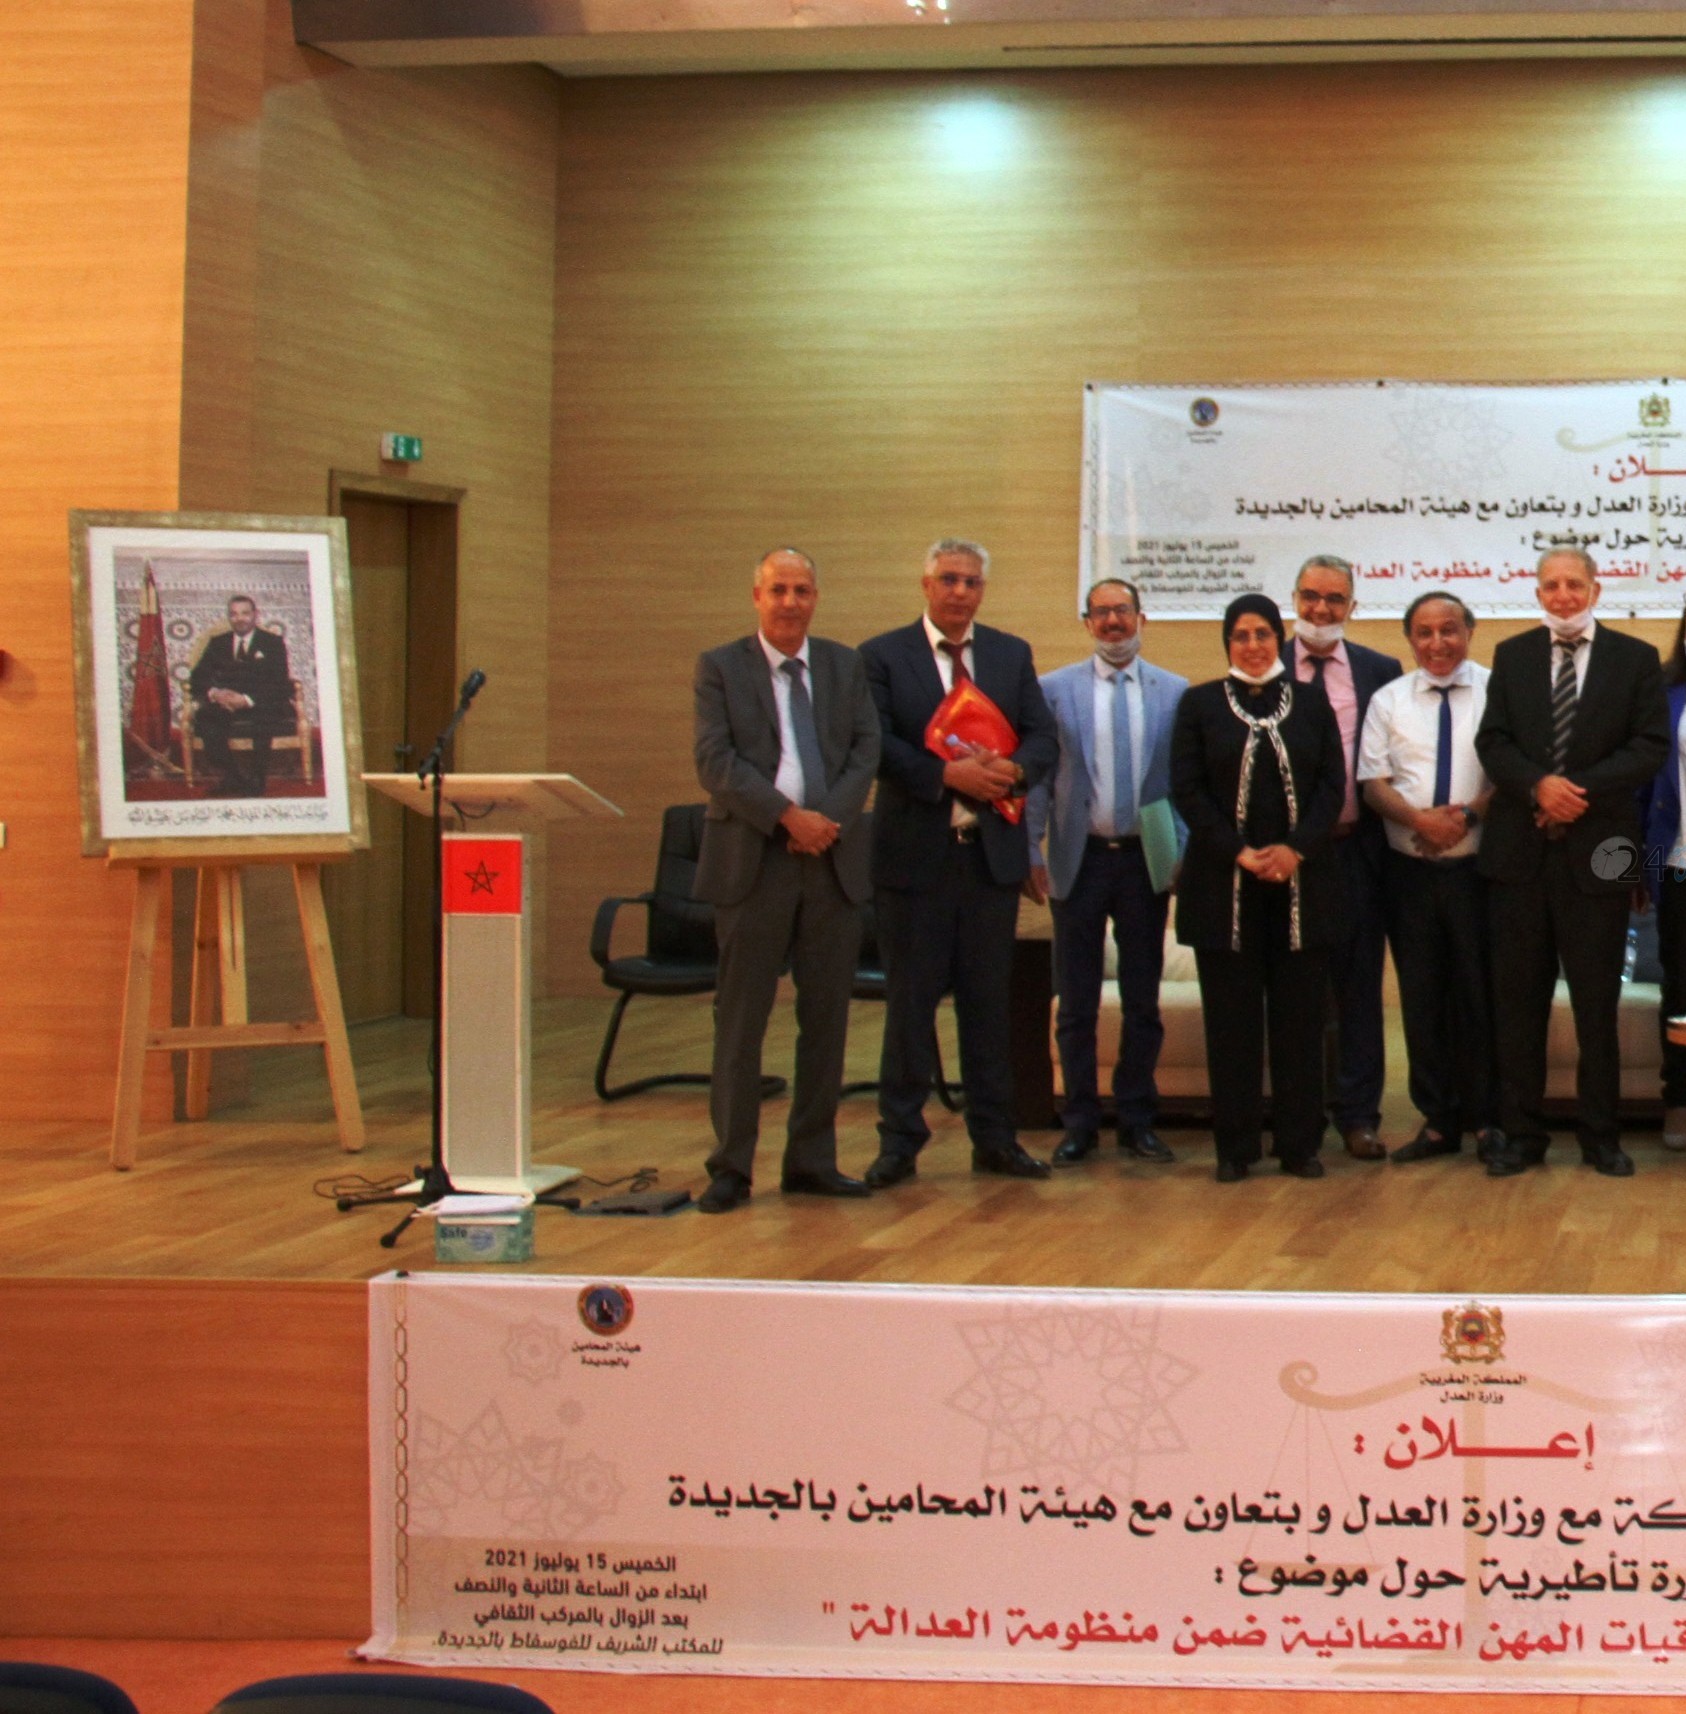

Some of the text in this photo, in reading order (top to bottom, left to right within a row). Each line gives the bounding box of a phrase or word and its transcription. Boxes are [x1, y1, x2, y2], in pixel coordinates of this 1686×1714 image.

[1235, 497, 1325, 520] بالجديدة
[1329, 498, 1414, 520] المحامين
[1476, 501, 1500, 521] مع
[1505, 496, 1566, 519] بتعاون
[1587, 496, 1641, 517] العدل
[1532, 528, 1601, 552] موضوع
[1606, 529, 1651, 550] حول
[1411, 561, 1492, 583] منظومة
[1420, 1373, 1527, 1386] المملكة المغربية
[1440, 1391, 1504, 1404] وزارة العدل
[1383, 1415, 1595, 1471] إعلان
[668, 1474, 838, 1522] بالجديدة
[847, 1482, 1007, 1524] المحامين
[1019, 1485, 1118, 1529] هيئة
[1183, 1491, 1302, 1535] بتعاون
[1342, 1493, 1449, 1535] العدل
[1128, 1499, 1173, 1537] مع
[1308, 1503, 1332, 1535] و
[1462, 1495, 1546, 1538] وزارة
[1556, 1507, 1603, 1546] مع
[485, 1548, 677, 1575] الخميس 15 يوليوز 2021
[1238, 1553, 1369, 1597] موضوع
[1380, 1556, 1467, 1599] حول
[1478, 1550, 1640, 1601] تأطيرية
[455, 1576, 708, 1603] ابتداء من الساعة الثانية والنصف
[474, 1602, 689, 1630] بعد الزوال بالمركب الثقافي
[849, 1602, 991, 1642] العدالة
[1006, 1607, 1159, 1652] منظومة
[509, 1630, 592, 1653] للفوسفاط
[596, 1634, 658, 1655] الشريف
[662, 1637, 724, 1656] للمكتب
[1172, 1613, 1268, 1656] ضمن
[1281, 1612, 1463, 1658] القضائية
[1478, 1620, 1584, 1662] المهن
